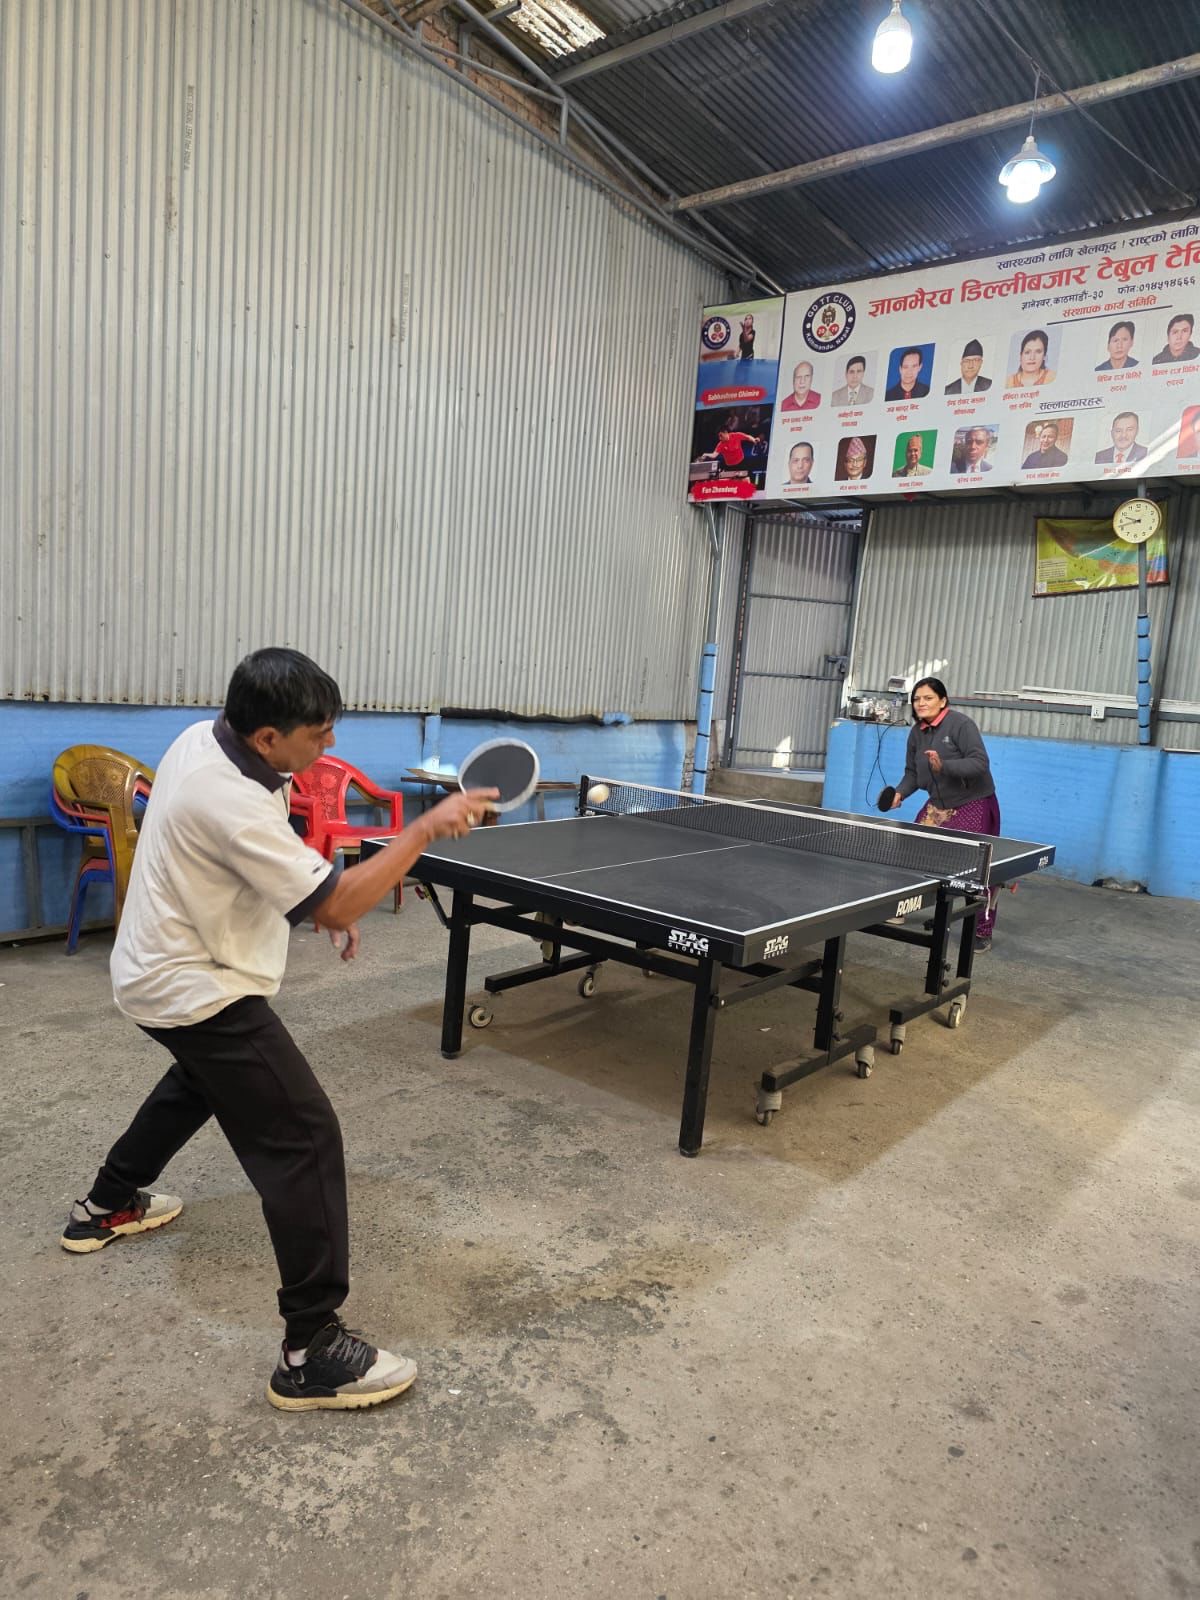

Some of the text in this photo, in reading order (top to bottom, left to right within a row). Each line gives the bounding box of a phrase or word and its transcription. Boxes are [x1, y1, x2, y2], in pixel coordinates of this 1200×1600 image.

[1049, 248, 1074, 261] लागि
[1170, 225, 1198, 239] लागि
[868, 287, 954, 317] ज्ञानभैरव
[961, 265, 1090, 303] डिल्लीबजार
[1097, 254, 1158, 282] टेबुल
[833, 295, 853, 312] CLUB
[1128, 294, 1158, 309] समिति
[896, 895, 922, 917] ROMA
[668, 929, 708, 952] STAG
[764, 936, 788, 953] STAG
